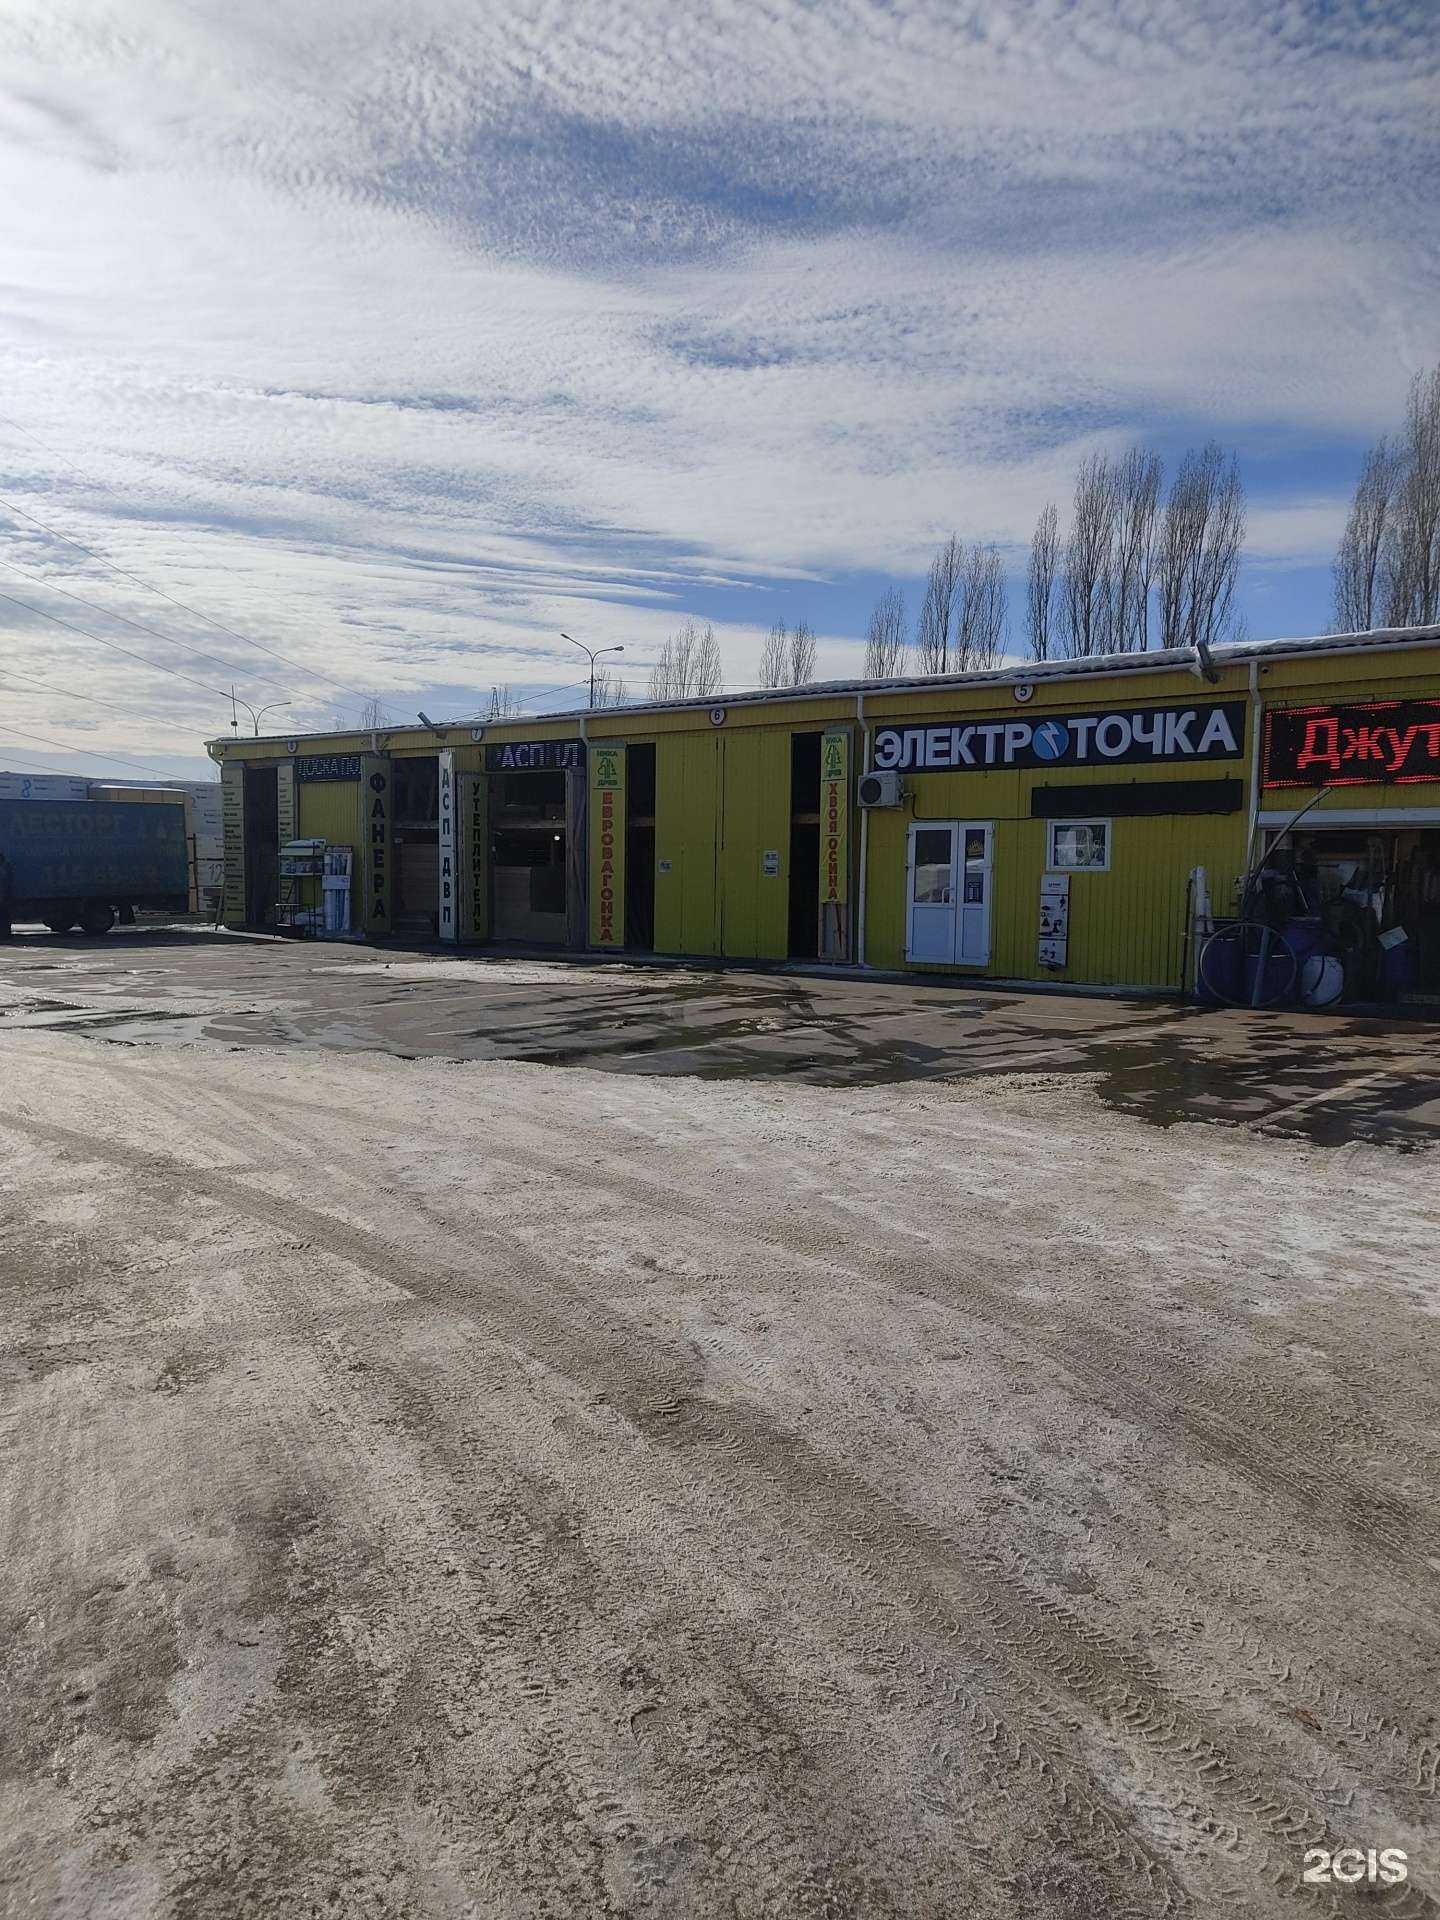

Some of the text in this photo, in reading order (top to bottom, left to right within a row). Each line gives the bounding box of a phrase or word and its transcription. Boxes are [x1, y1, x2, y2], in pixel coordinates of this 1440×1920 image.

[369, 772, 386, 919] ФАНЕРА
[472, 782, 481, 933] УТЕПЛИТЕЛЬ
[599, 791, 614, 942] ЕВРОВАГОНКА
[827, 837, 839, 900] ОСИНА
[828, 782, 838, 833] ХВОЯ
